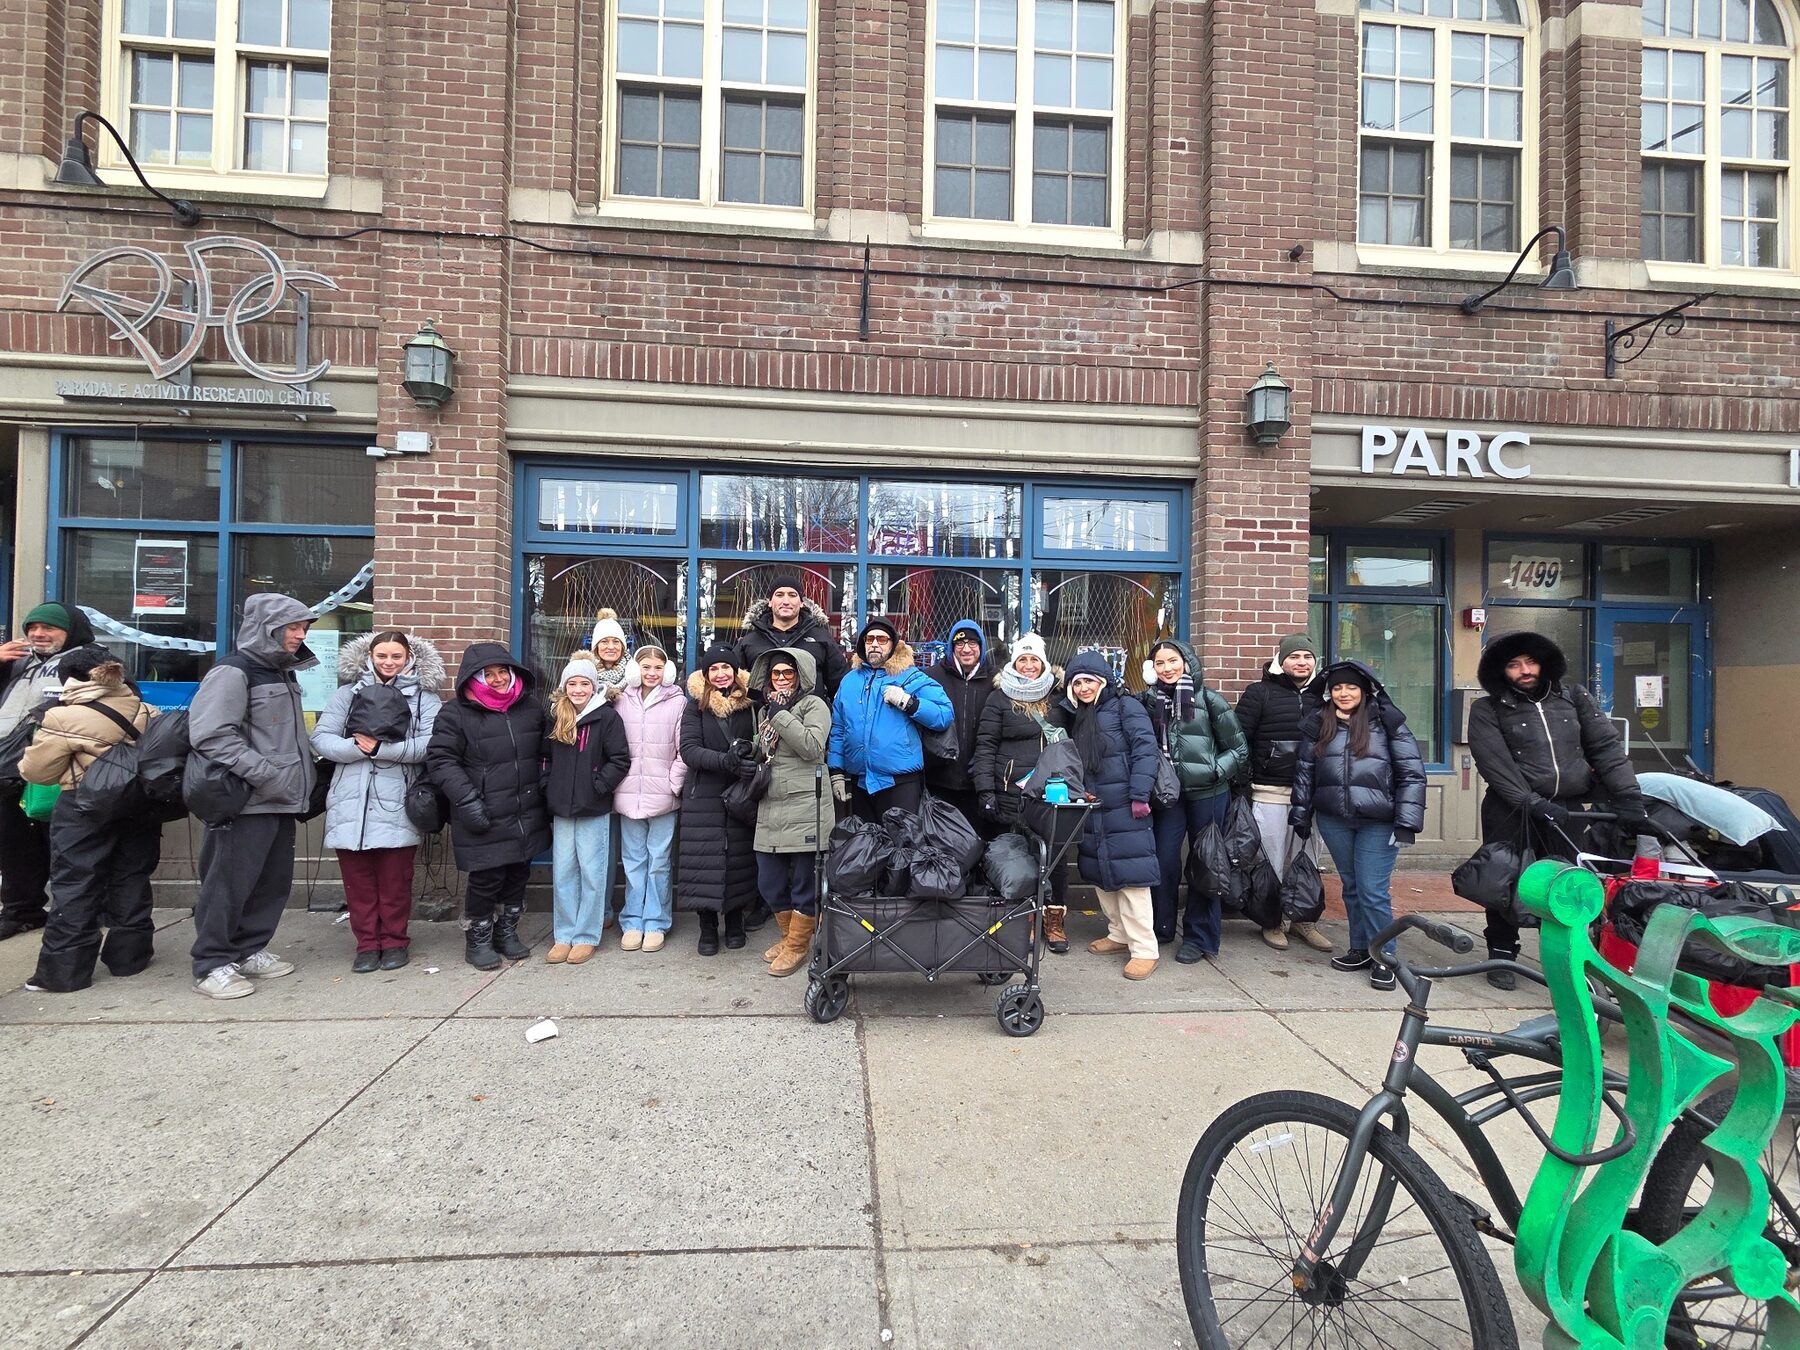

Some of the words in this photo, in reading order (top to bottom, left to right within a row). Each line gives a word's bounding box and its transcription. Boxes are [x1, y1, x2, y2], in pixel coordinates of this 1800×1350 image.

[56, 381, 128, 397] PARKDALE
[134, 383, 190, 400] ACTIVITY
[192, 385, 273, 403] RECREATION
[279, 389, 331, 406] CENTRE
[1361, 425, 1531, 479] PARC
[1510, 560, 1560, 588] 1499
[1448, 1034, 1497, 1047] CAPITOL
